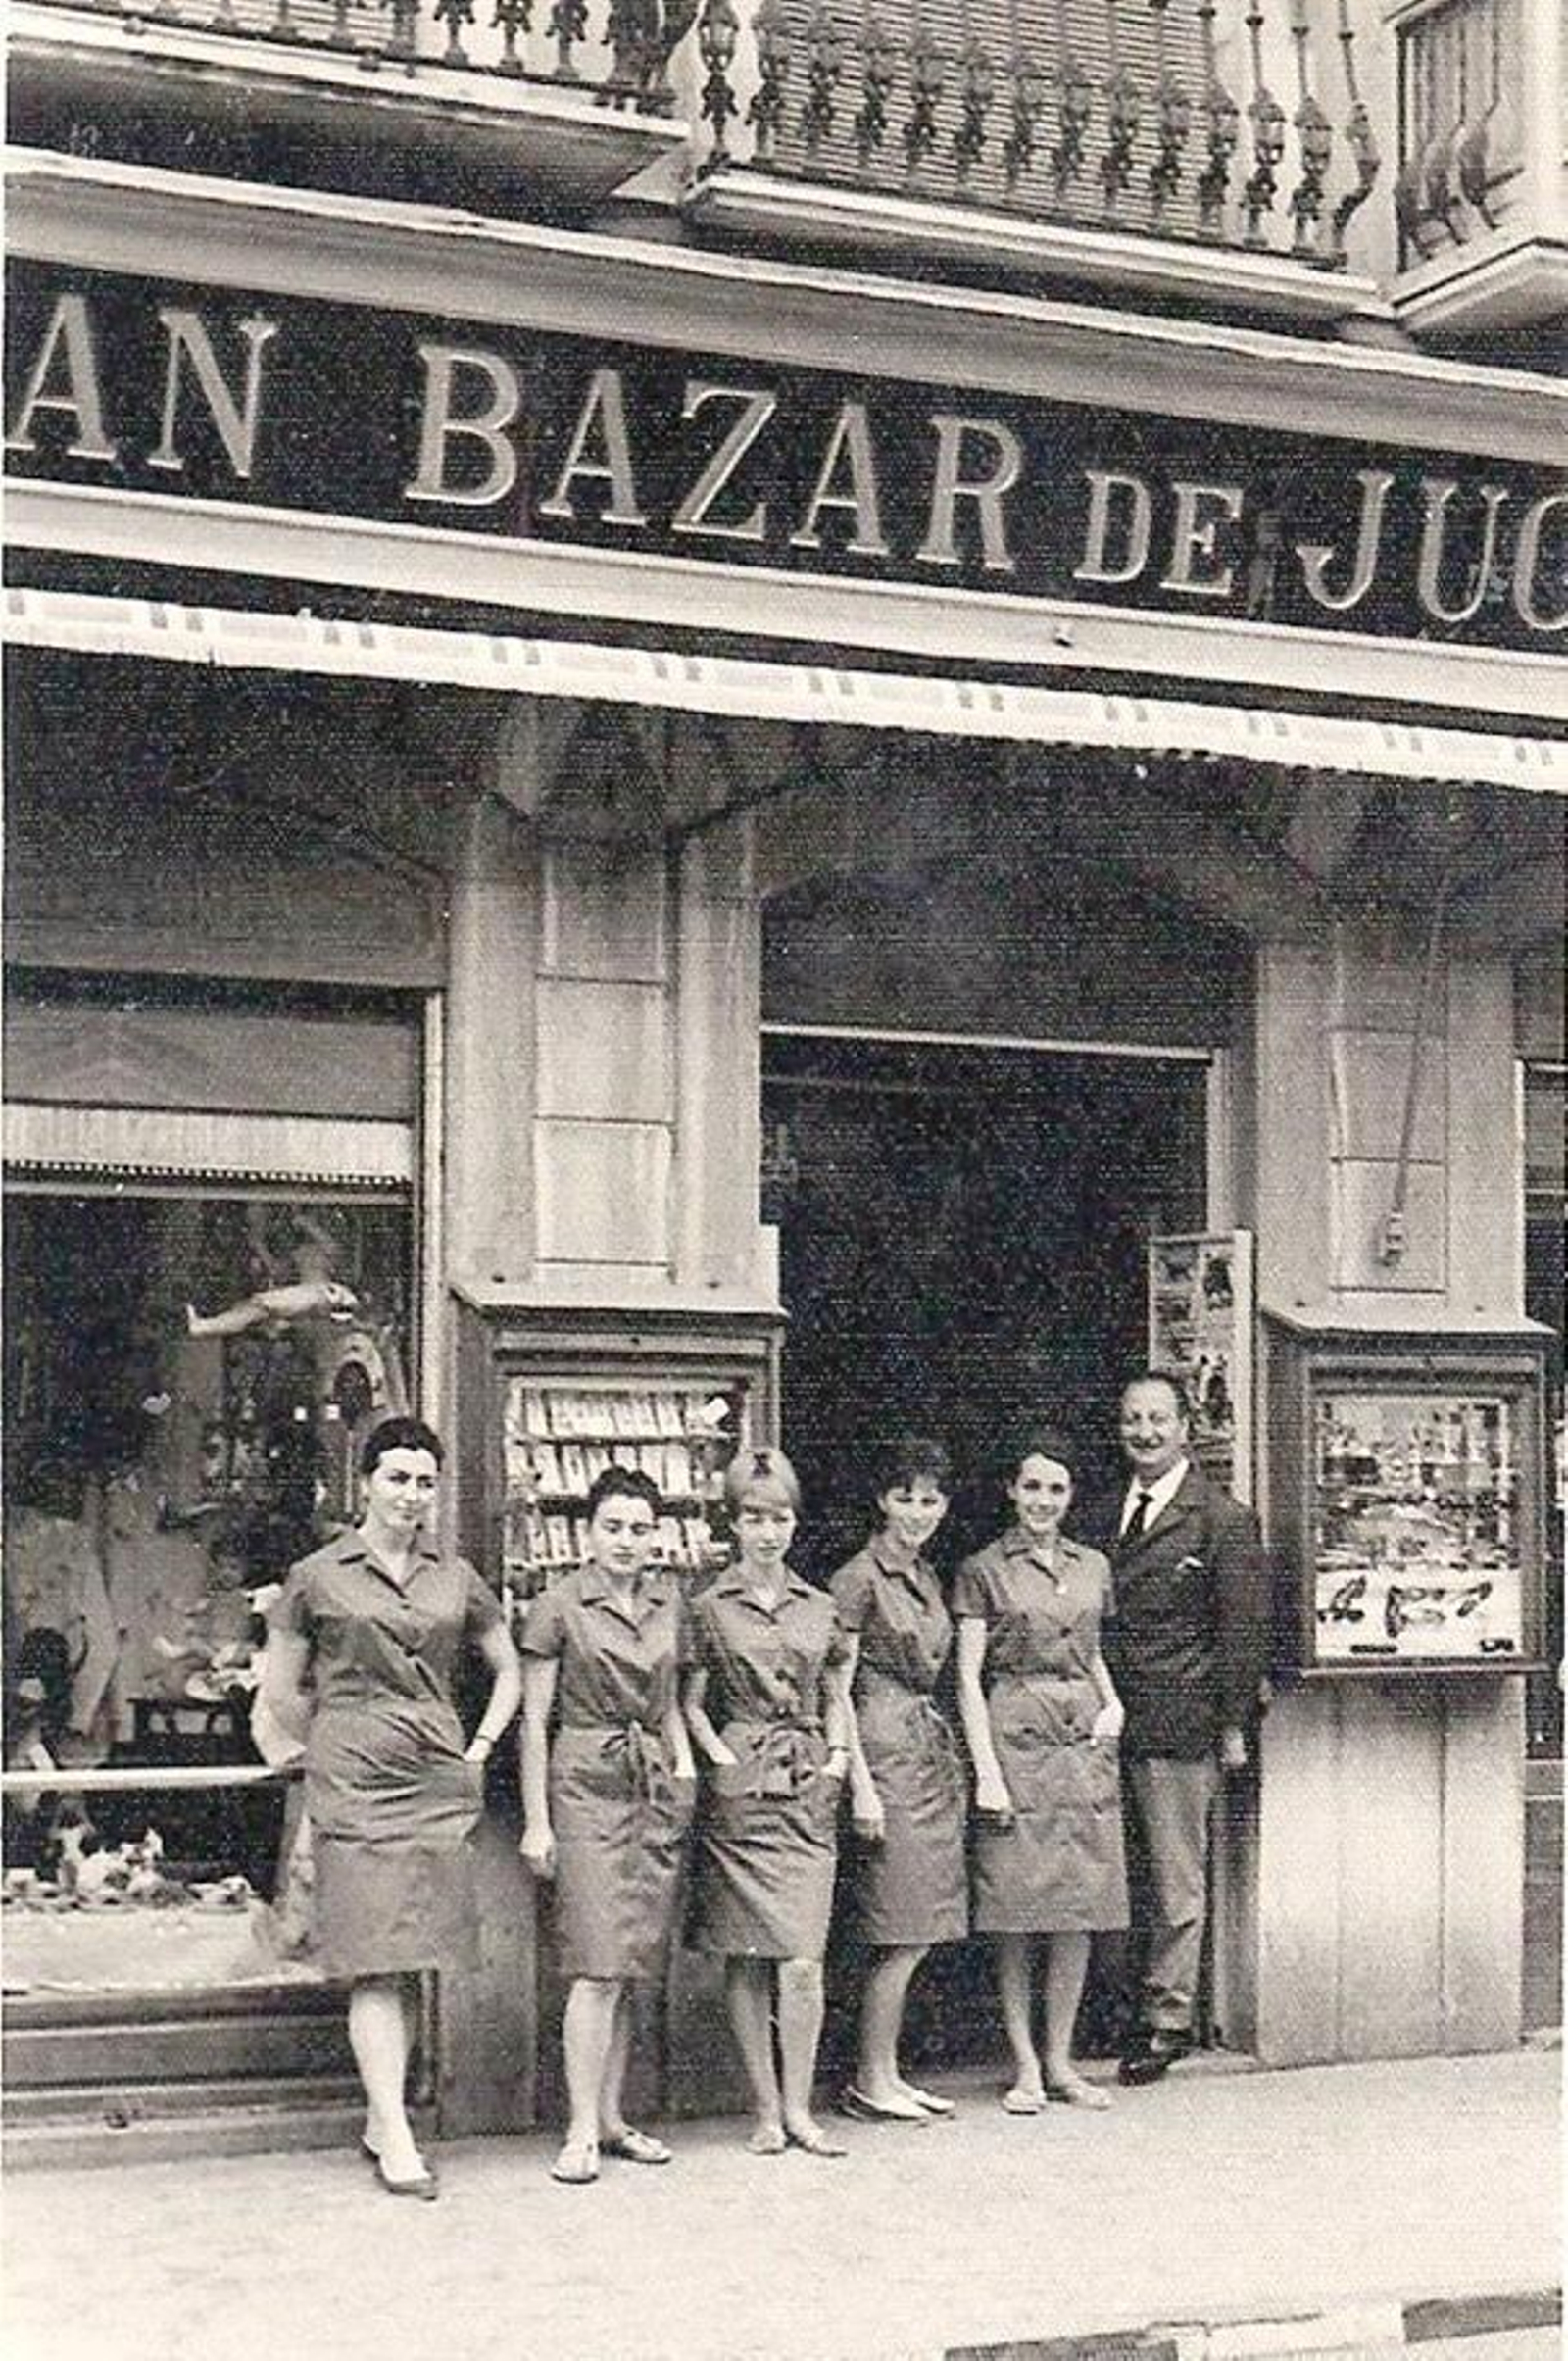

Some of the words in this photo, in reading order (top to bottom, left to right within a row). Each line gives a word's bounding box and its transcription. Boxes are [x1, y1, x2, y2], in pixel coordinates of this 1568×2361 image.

[5, 294, 277, 478] AN
[405, 346, 1022, 571] BAZAR
[1074, 470, 1243, 594] DE
